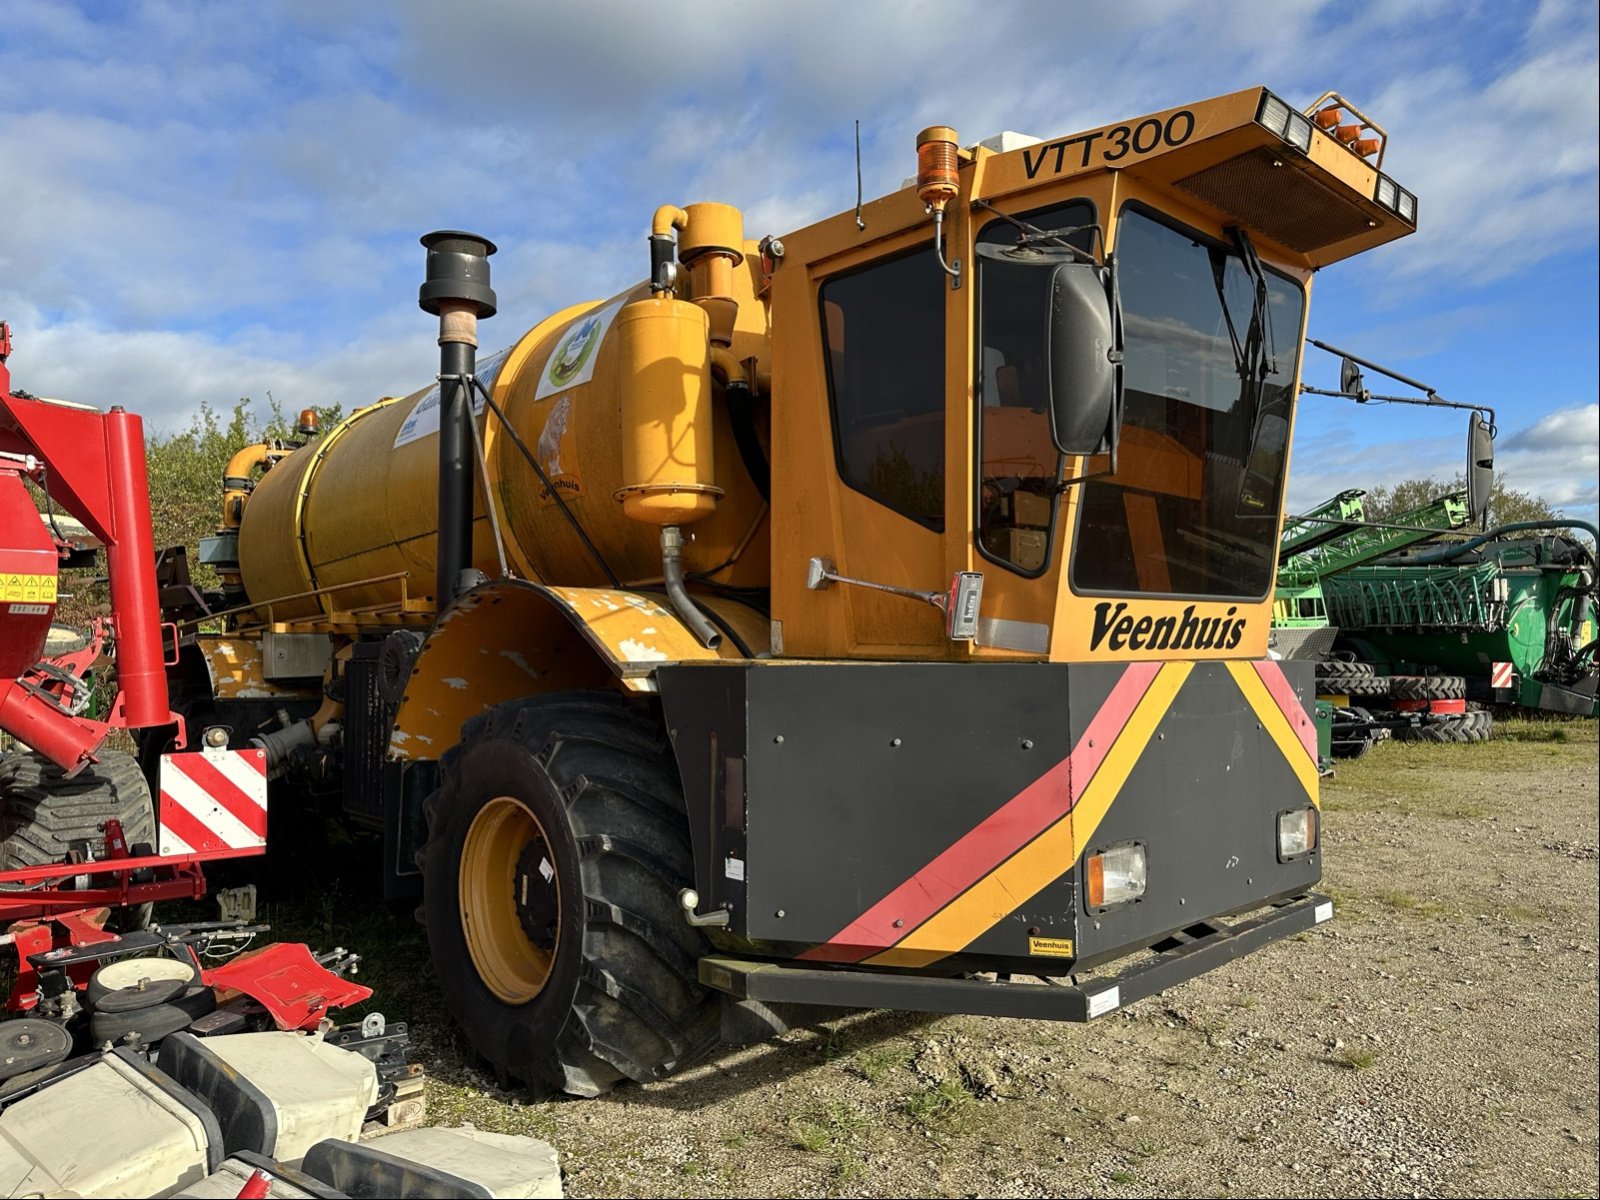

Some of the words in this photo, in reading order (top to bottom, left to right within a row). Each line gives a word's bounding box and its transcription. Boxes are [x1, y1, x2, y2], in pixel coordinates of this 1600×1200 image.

[1022, 110, 1195, 180] VTT300
[540, 479, 580, 500] Venhuis
[1090, 602, 1247, 652] Veenhuis
[1033, 940, 1070, 950] Veenhuis
